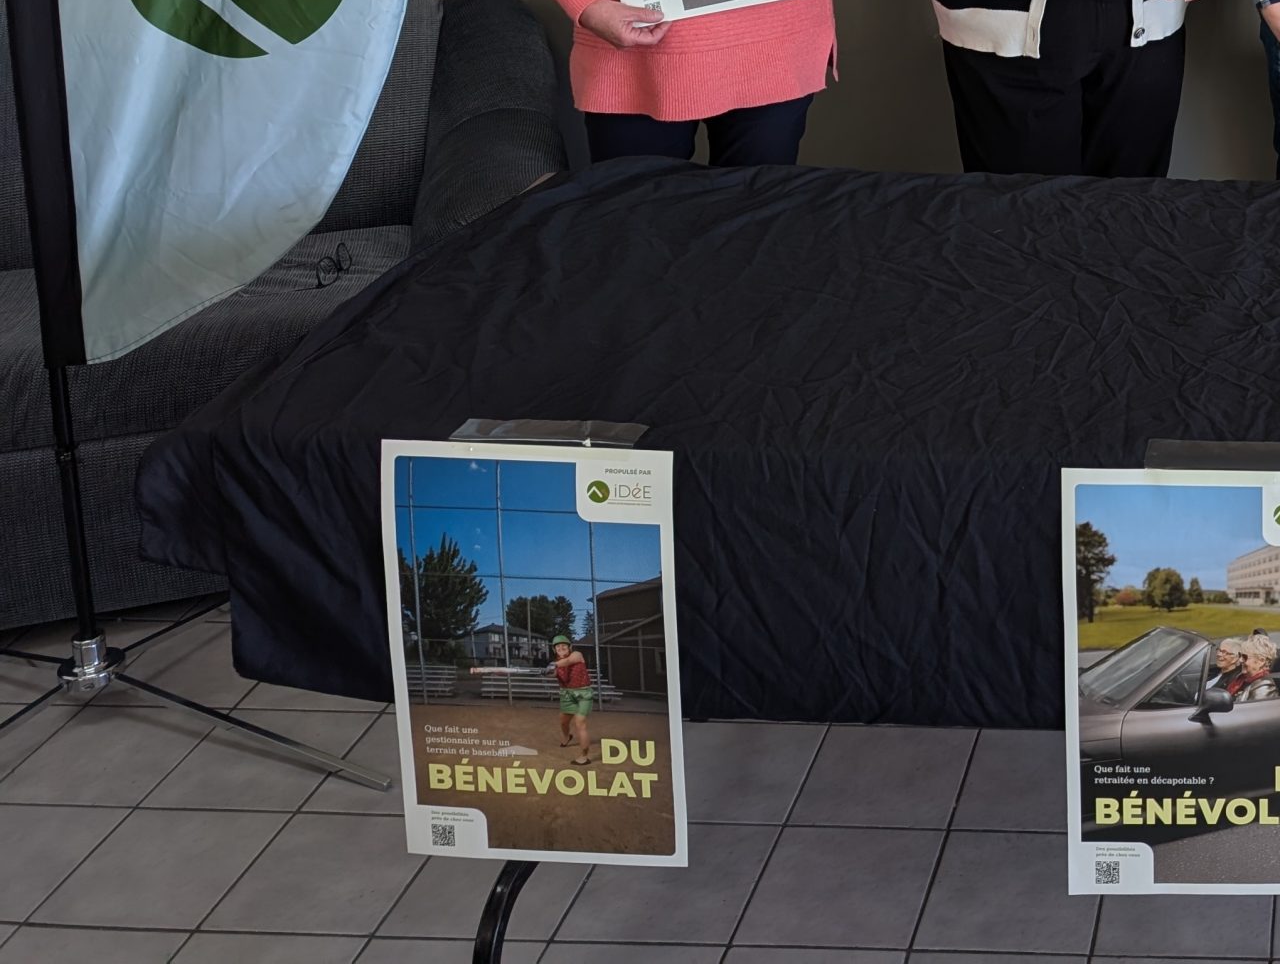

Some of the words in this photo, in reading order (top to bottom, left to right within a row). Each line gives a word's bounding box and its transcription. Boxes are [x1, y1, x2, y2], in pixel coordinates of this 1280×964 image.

[614, 483, 652, 499] iDéE
[424, 724, 443, 733] Que
[444, 725, 460, 733] fait
[425, 736, 480, 745] gestionnaire
[482, 738, 497, 746] sur
[426, 746, 456, 754] terrain
[459, 747, 470, 755] de
[600, 738, 655, 766] DU
[1094, 765, 1113, 774] Que
[1115, 765, 1131, 773] fait
[428, 758, 658, 798] BÉNÉVOLAT
[1094, 776, 1135, 784] retraitée
[1150, 776, 1207, 786] décapotable
[1209, 776, 1215, 785] ?
